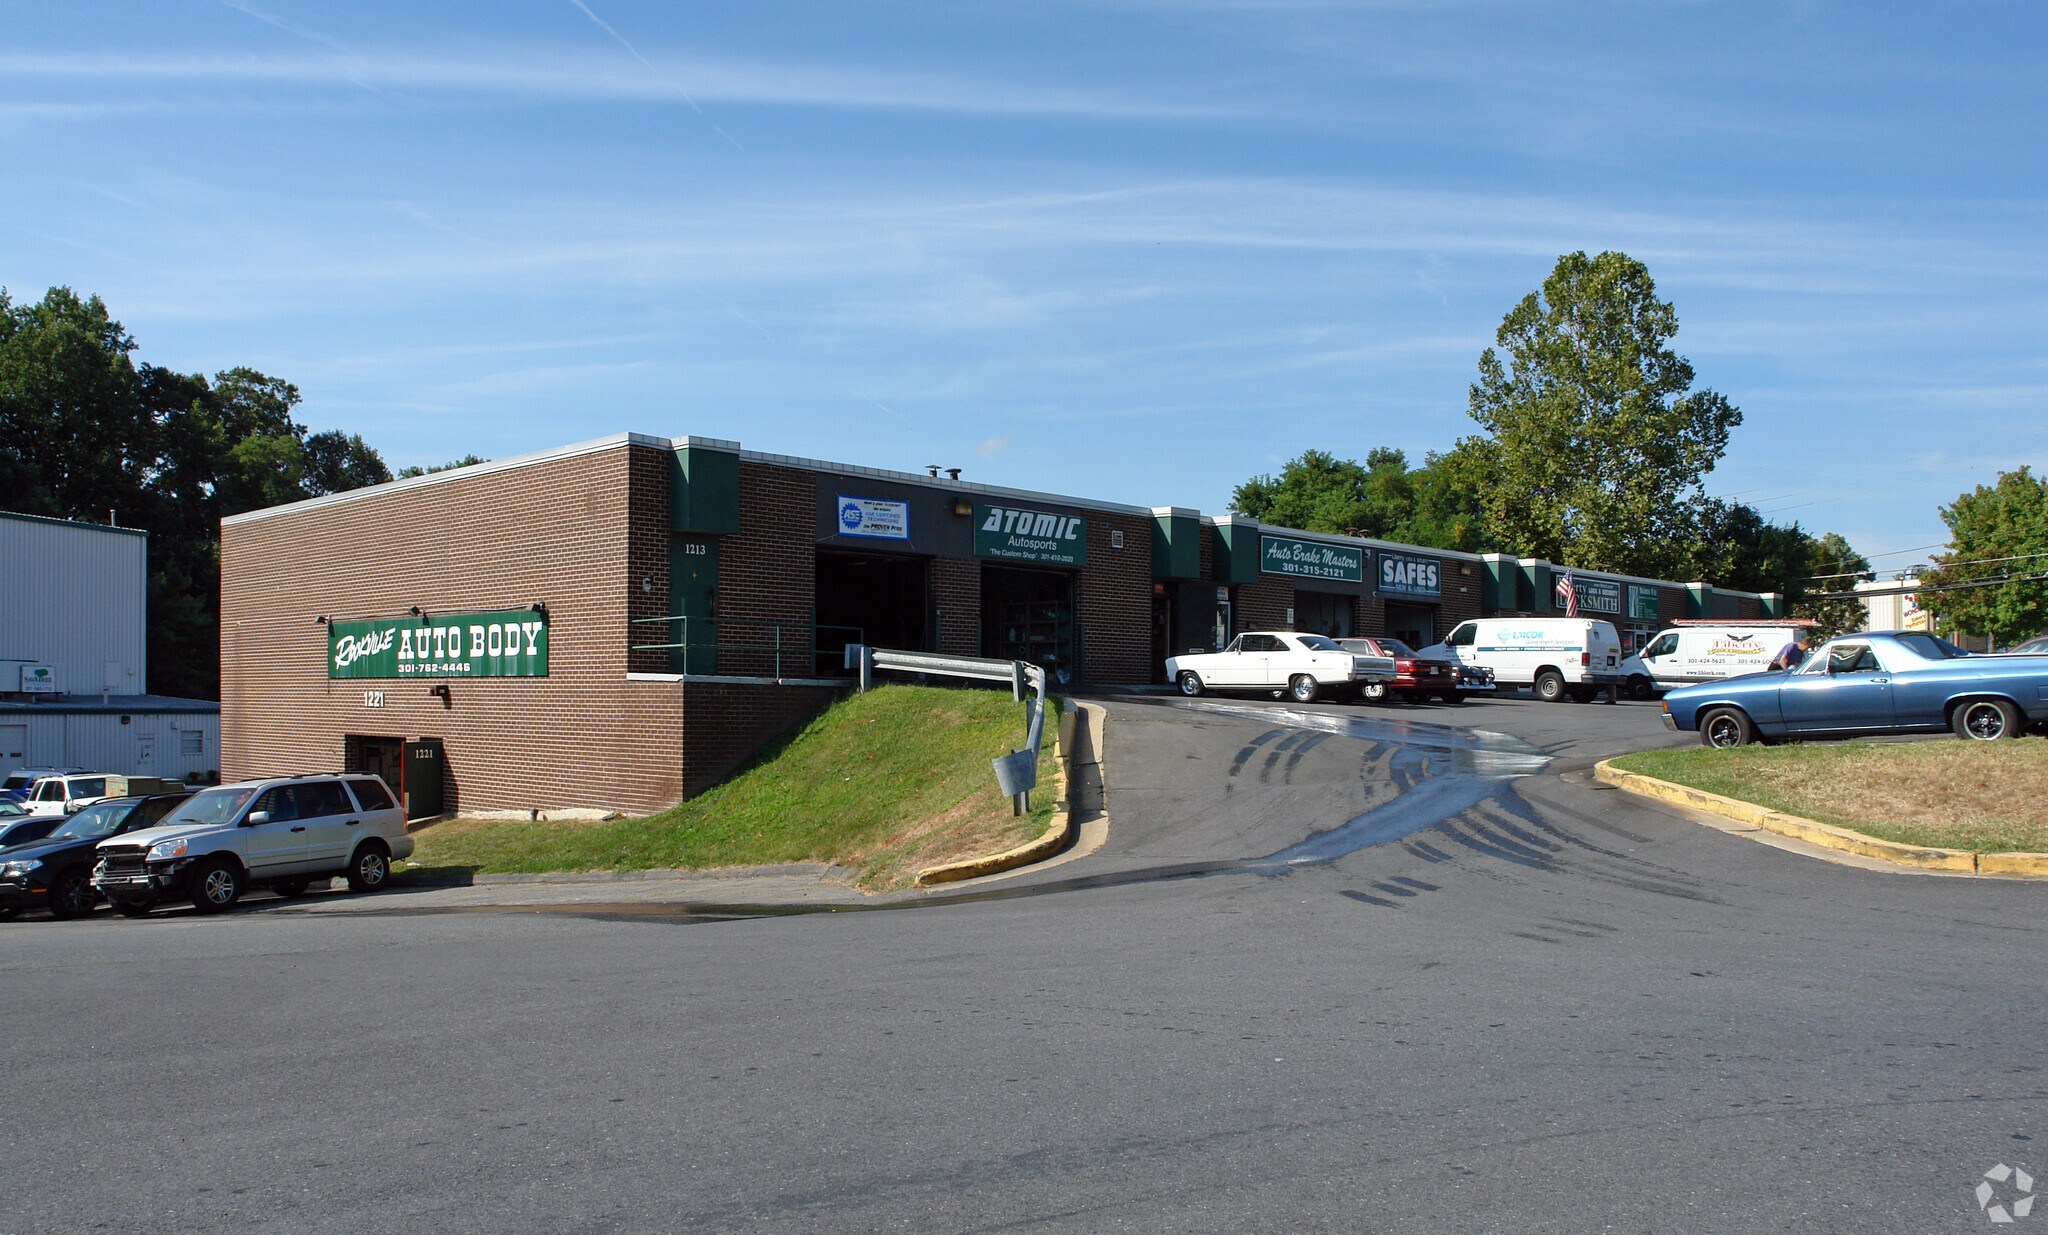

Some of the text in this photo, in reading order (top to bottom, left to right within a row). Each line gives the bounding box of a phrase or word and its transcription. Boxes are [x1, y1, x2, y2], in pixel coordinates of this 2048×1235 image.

[844, 509, 860, 520] ASE
[981, 508, 1081, 540] ATOMIC
[685, 543, 706, 555] 1213
[1007, 535, 1058, 551] Autosports
[1001, 549, 1022, 558] Custom
[1266, 542, 1358, 569] Auto Brake Masters
[1282, 563, 1344, 578] 301-315-2121
[1383, 559, 1437, 588] SAFES
[1559, 591, 1618, 611] LCKSMITH
[1903, 608, 1921, 617] WOND
[397, 626, 461, 660] AUTO
[469, 621, 542, 657] BODY
[1714, 639, 1762, 649] Liberty
[364, 690, 385, 708] 1221
[415, 749, 433, 759] 1221
